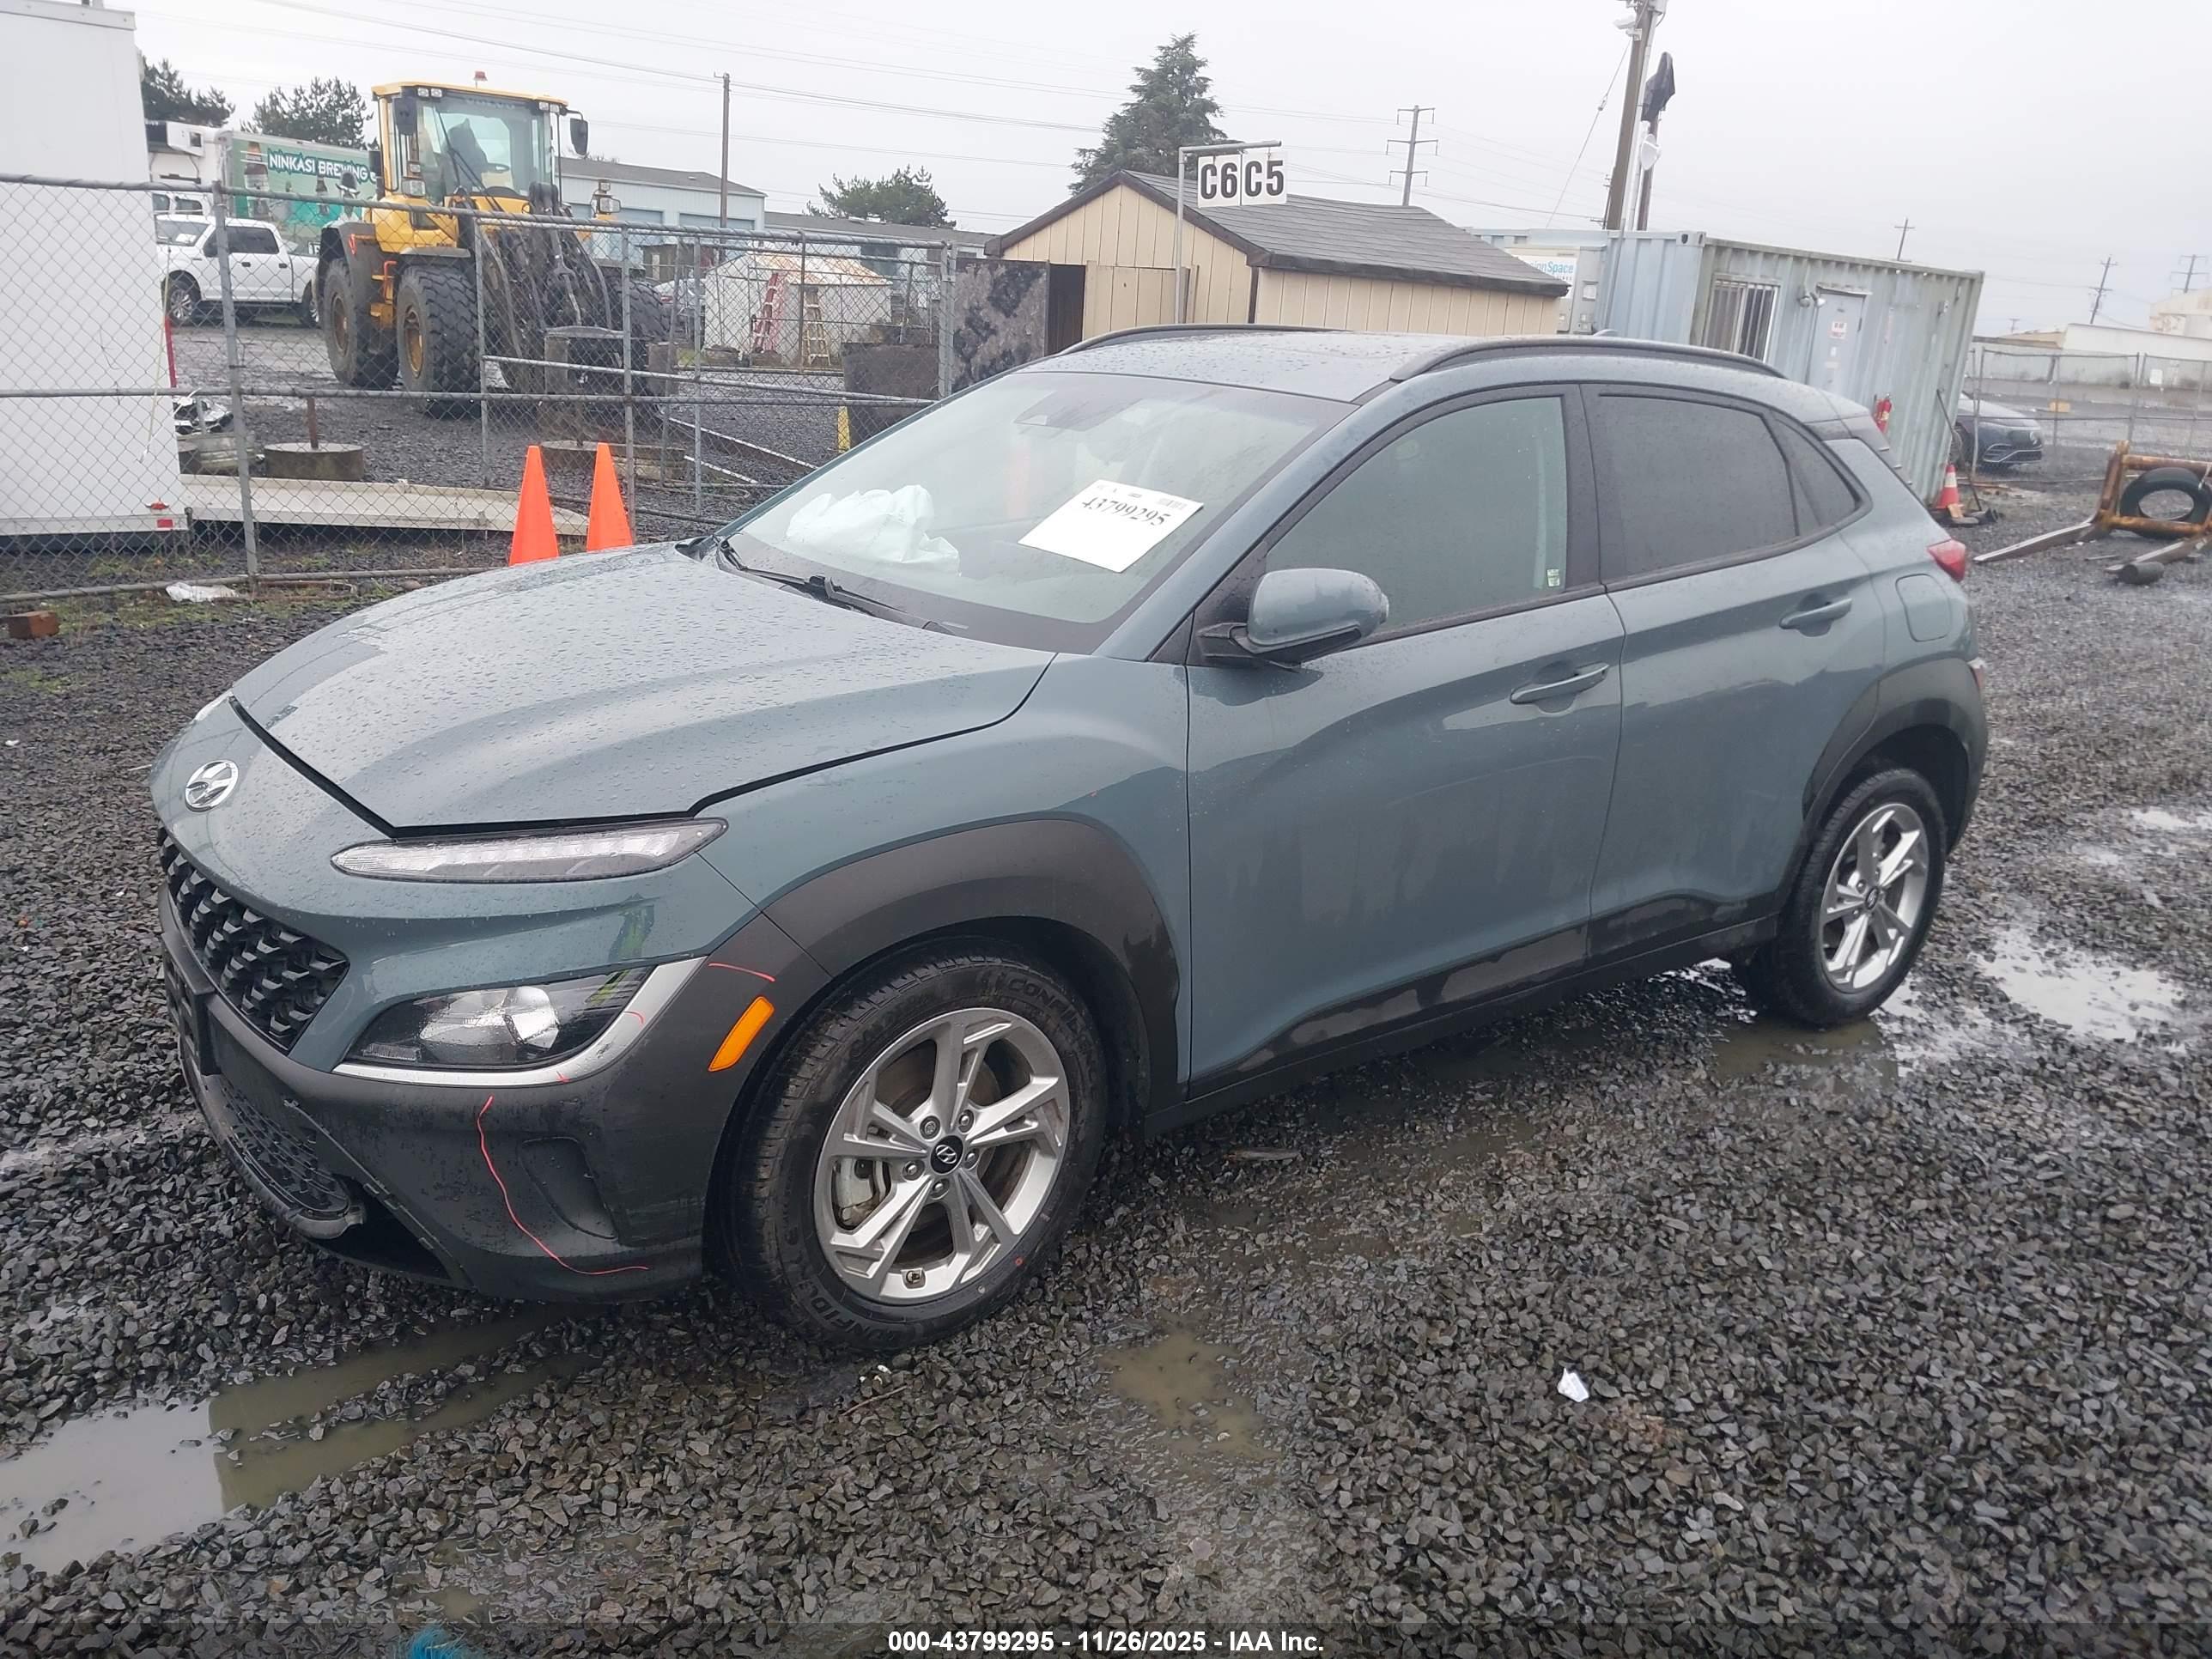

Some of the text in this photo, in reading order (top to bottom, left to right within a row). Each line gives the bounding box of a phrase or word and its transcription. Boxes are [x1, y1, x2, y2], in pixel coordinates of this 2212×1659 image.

[269, 153, 316, 173] NINKASI
[318, 161, 368, 180] BREWING
[1200, 162, 1237, 199] C6
[1245, 161, 1284, 196] C5
[1082, 497, 1170, 526] 43799295
